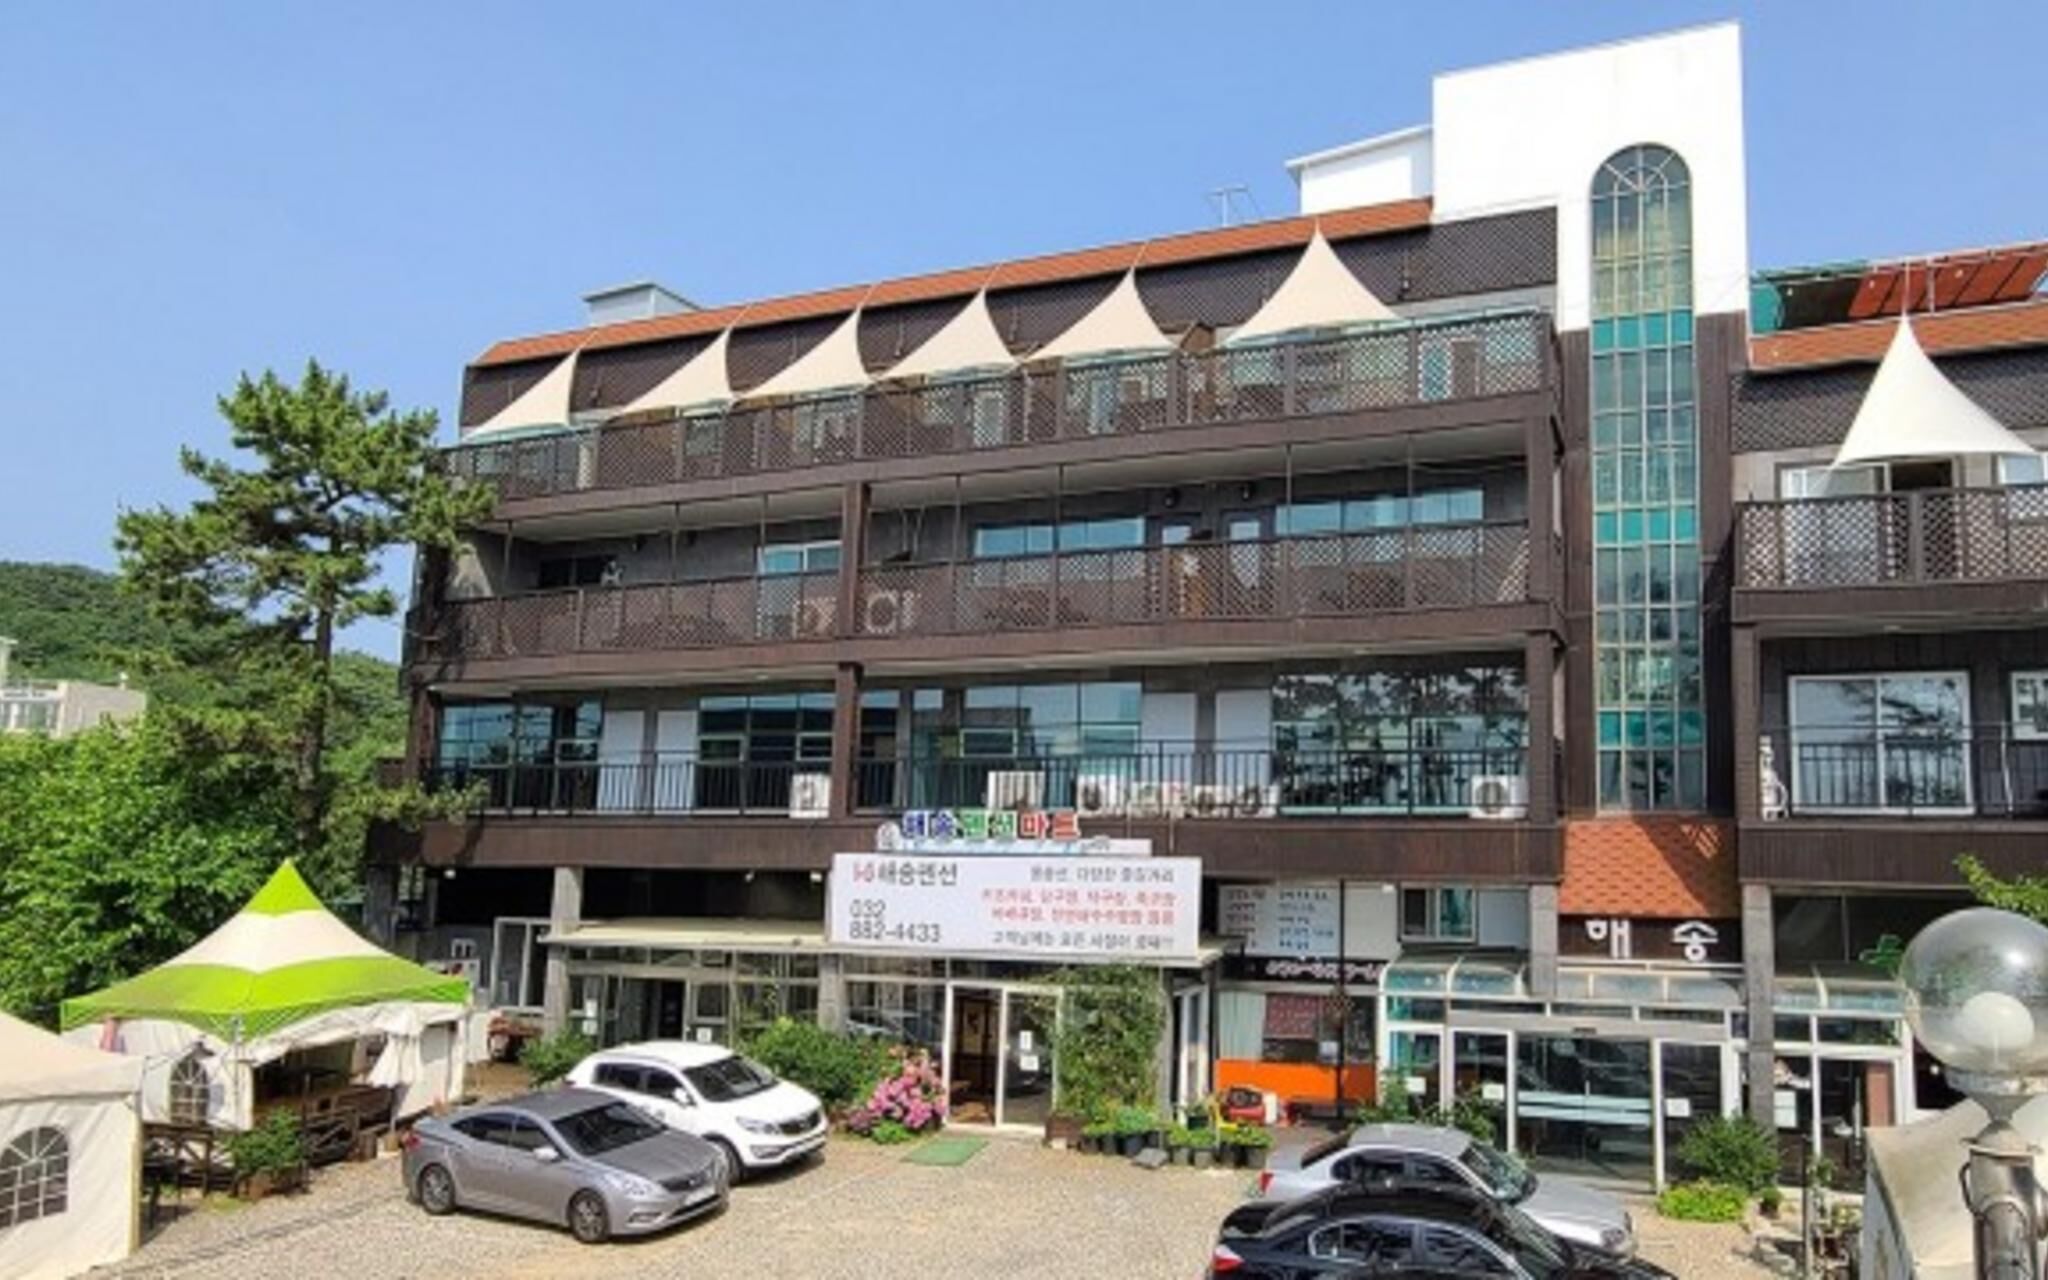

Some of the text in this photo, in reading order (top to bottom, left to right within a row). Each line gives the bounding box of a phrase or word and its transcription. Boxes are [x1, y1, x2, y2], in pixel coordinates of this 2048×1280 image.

[877, 860, 958, 886] 해송펜션
[849, 898, 886, 918] 032
[849, 919, 941, 943] 882-4433
